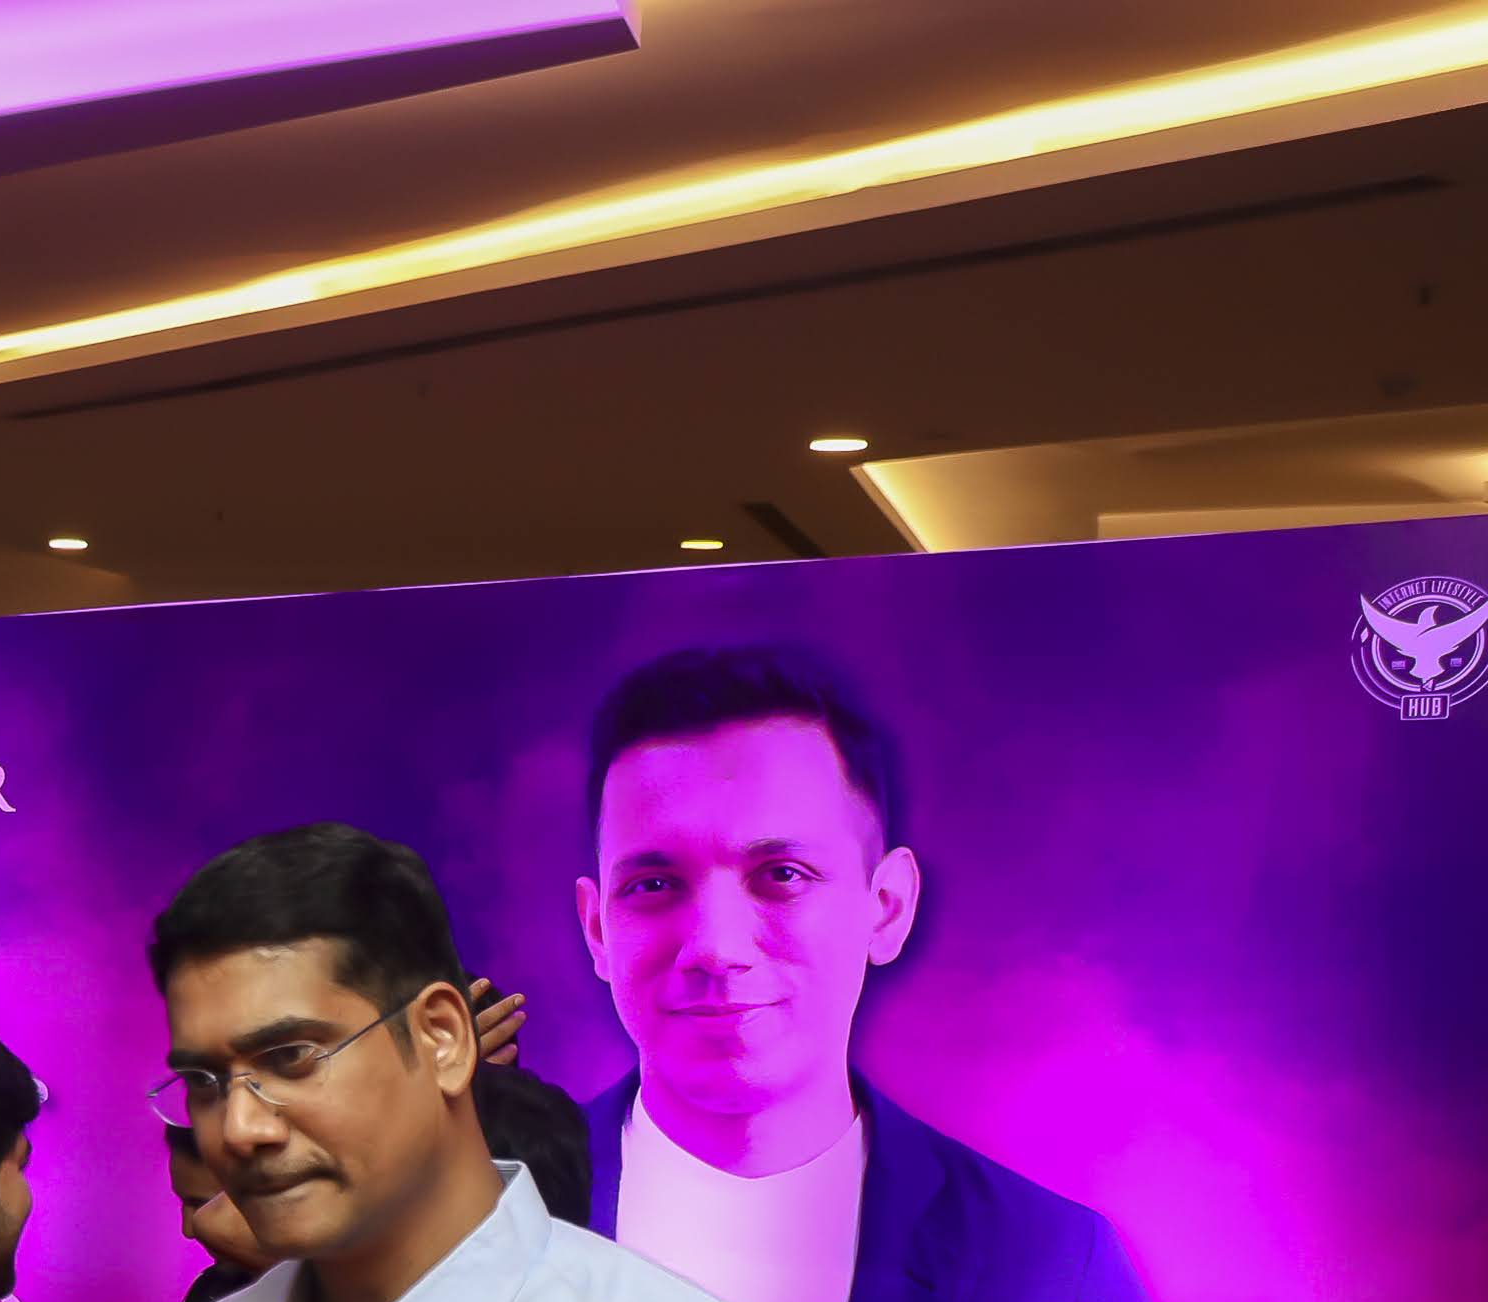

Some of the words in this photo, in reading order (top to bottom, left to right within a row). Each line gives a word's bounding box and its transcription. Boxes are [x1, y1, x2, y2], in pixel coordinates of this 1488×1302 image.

[1378, 581, 1427, 610] INTERNET
[1432, 580, 1484, 606] LIFESTYLE
[1409, 697, 1441, 717] HUB
